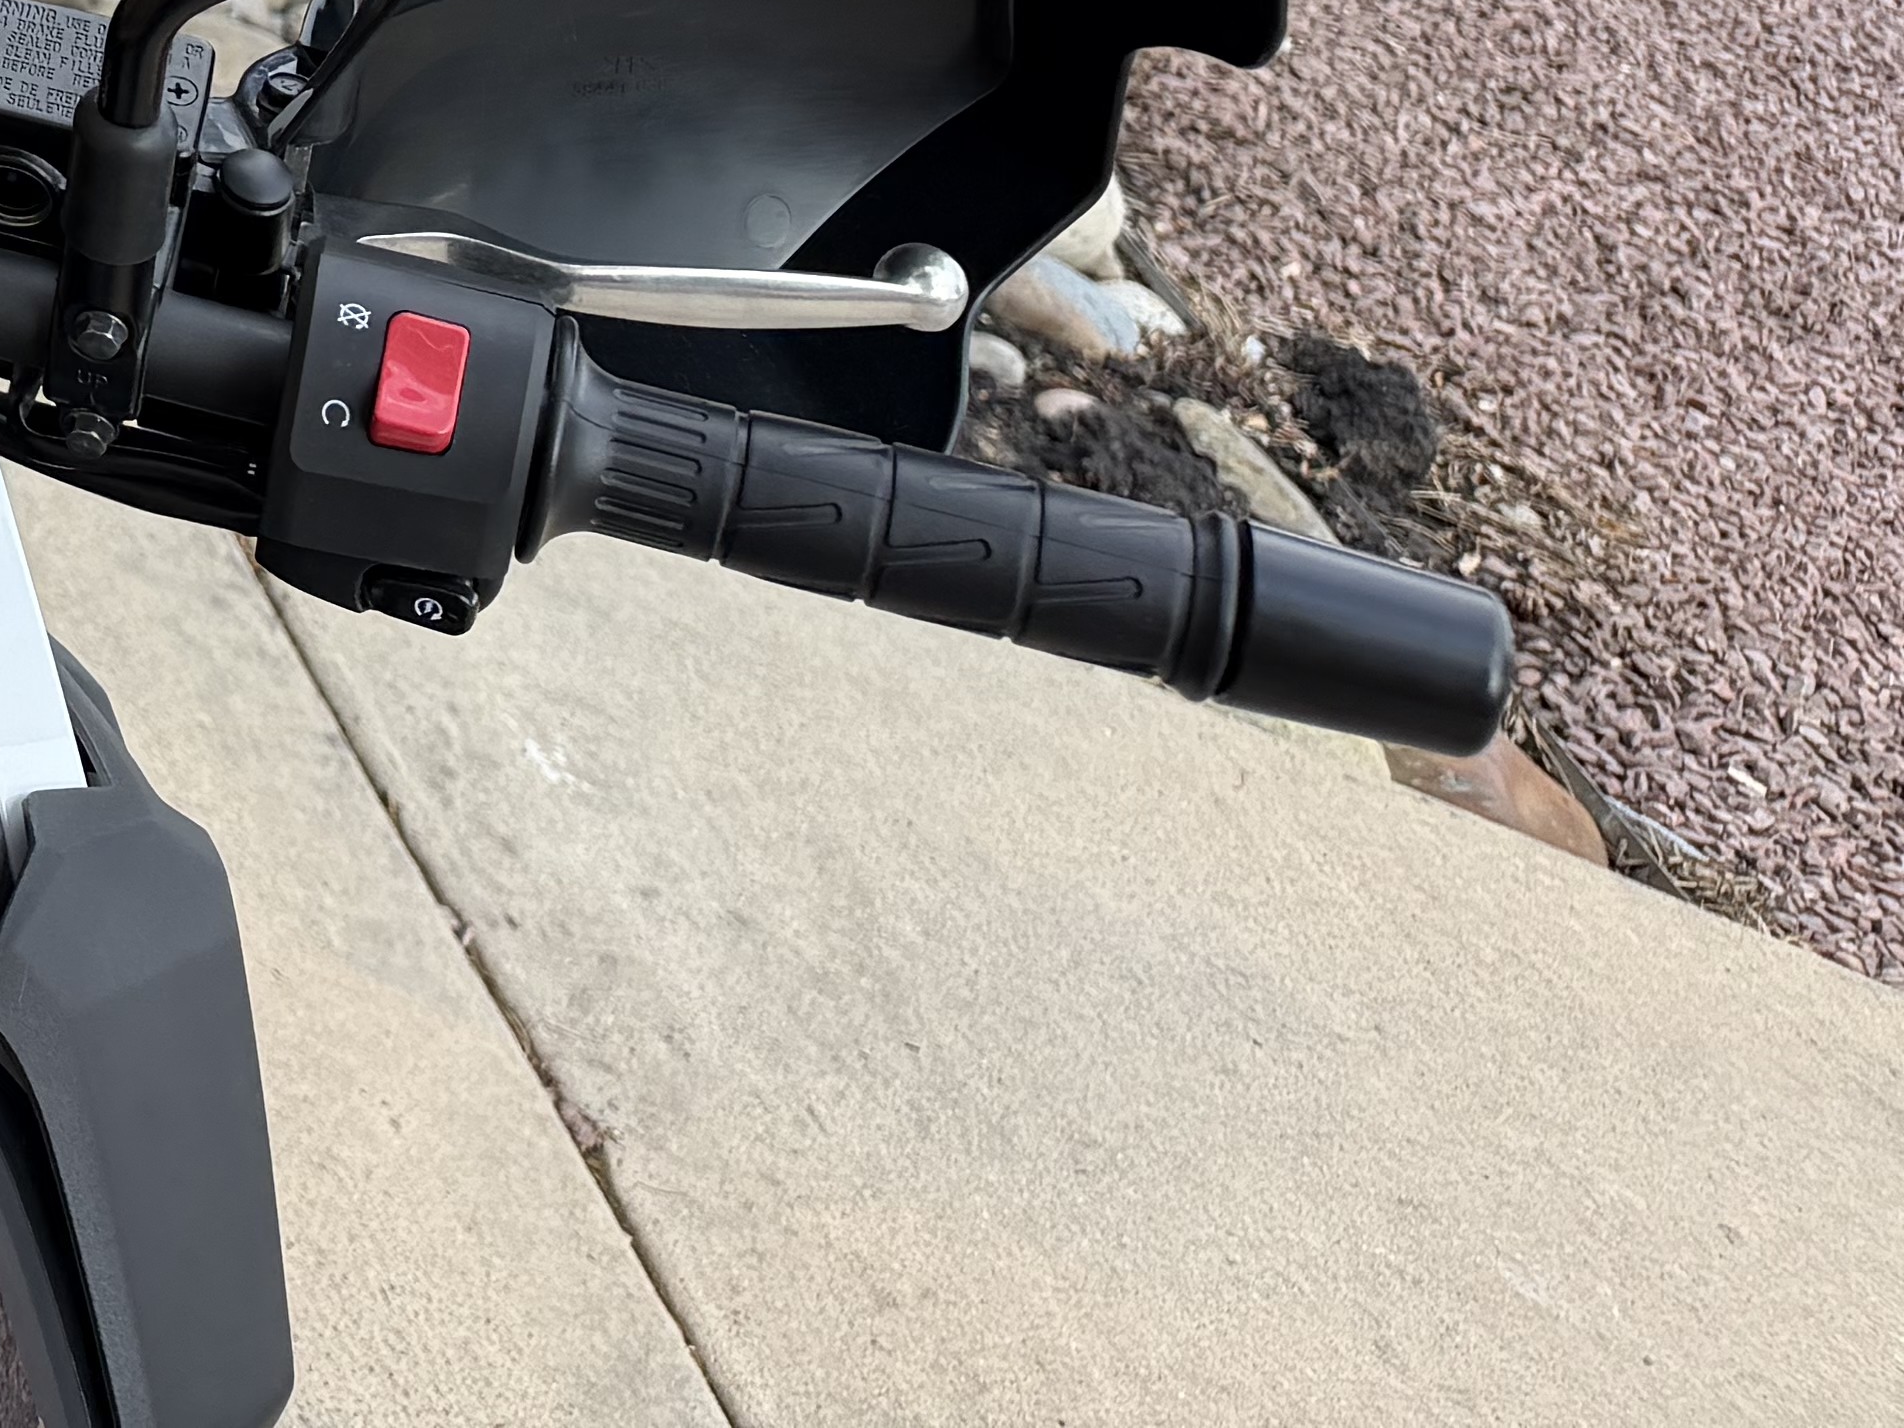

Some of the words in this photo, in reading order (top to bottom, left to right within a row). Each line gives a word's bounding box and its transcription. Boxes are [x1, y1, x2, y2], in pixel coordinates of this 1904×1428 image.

[17, 18, 64, 41] BRAKE
[74, 31, 104, 49] FLU
[66, 16, 91, 33] USE
[7, 31, 61, 53] SEALED
[2, 57, 55, 80] BEFORE
[5, 44, 52, 65] CLEAN
[59, 56, 101, 77] FILL
[20, 80, 38, 94] DE
[46, 87, 80, 105] FREI
[6, 93, 73, 118] SEULEME
[76, 368, 109, 389] UP
